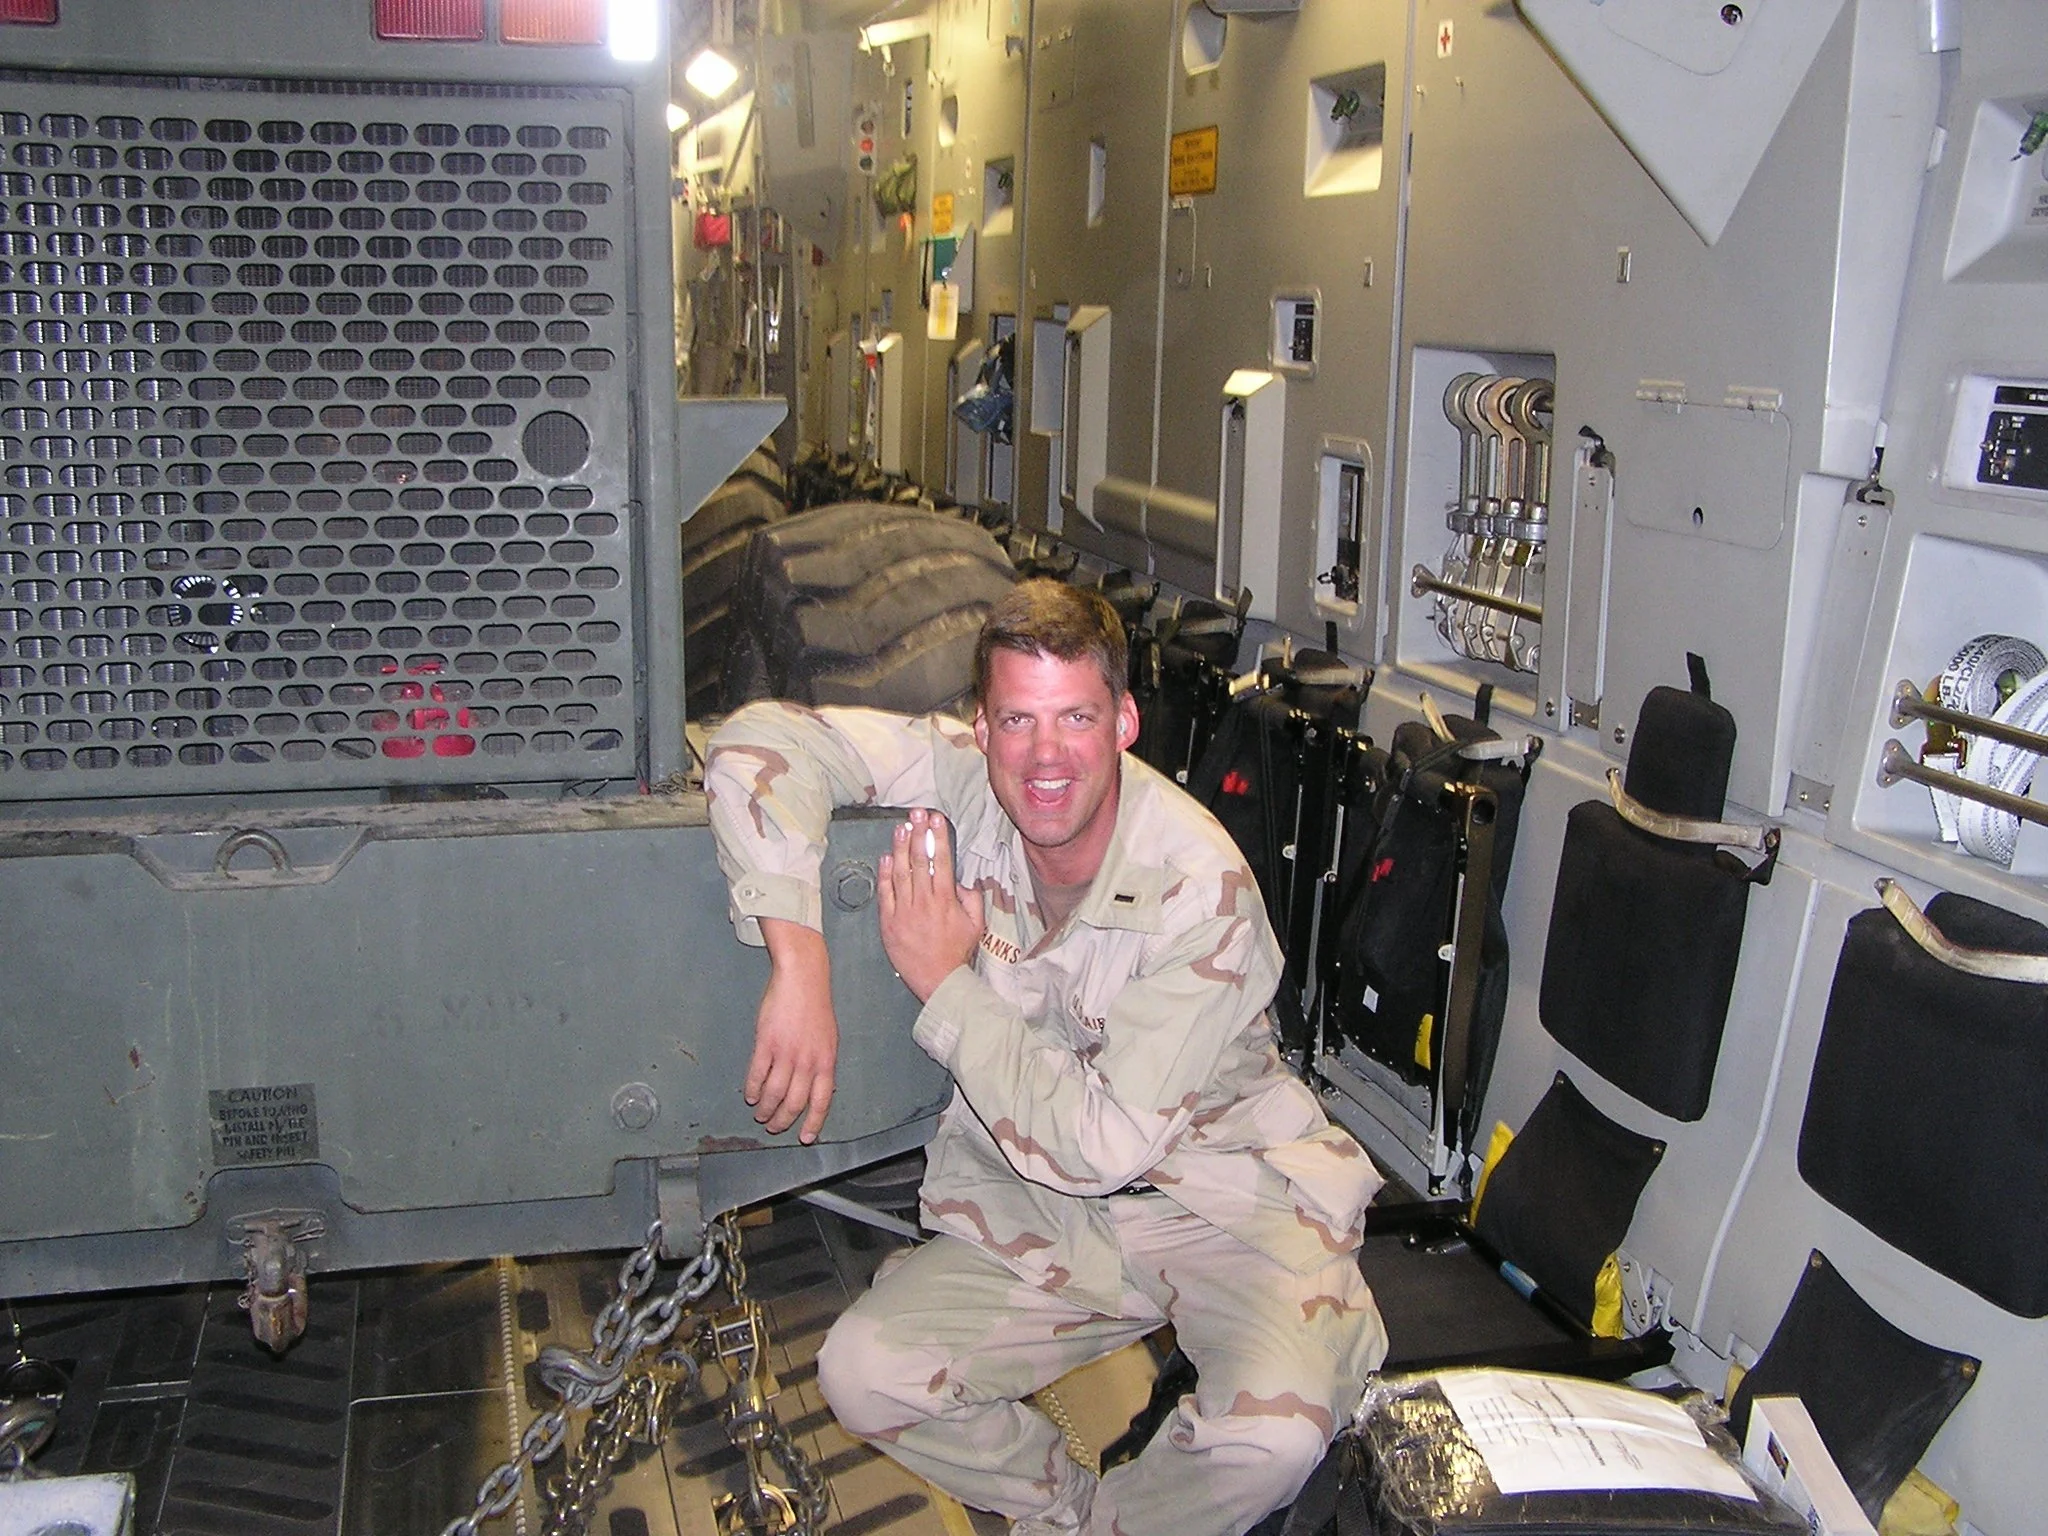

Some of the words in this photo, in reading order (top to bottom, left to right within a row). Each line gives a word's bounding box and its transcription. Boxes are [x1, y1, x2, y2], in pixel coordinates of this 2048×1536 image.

[228, 1087, 298, 1103] CAUTION
[219, 1107, 260, 1121] BEFORE
[245, 1134, 268, 1146] AND
